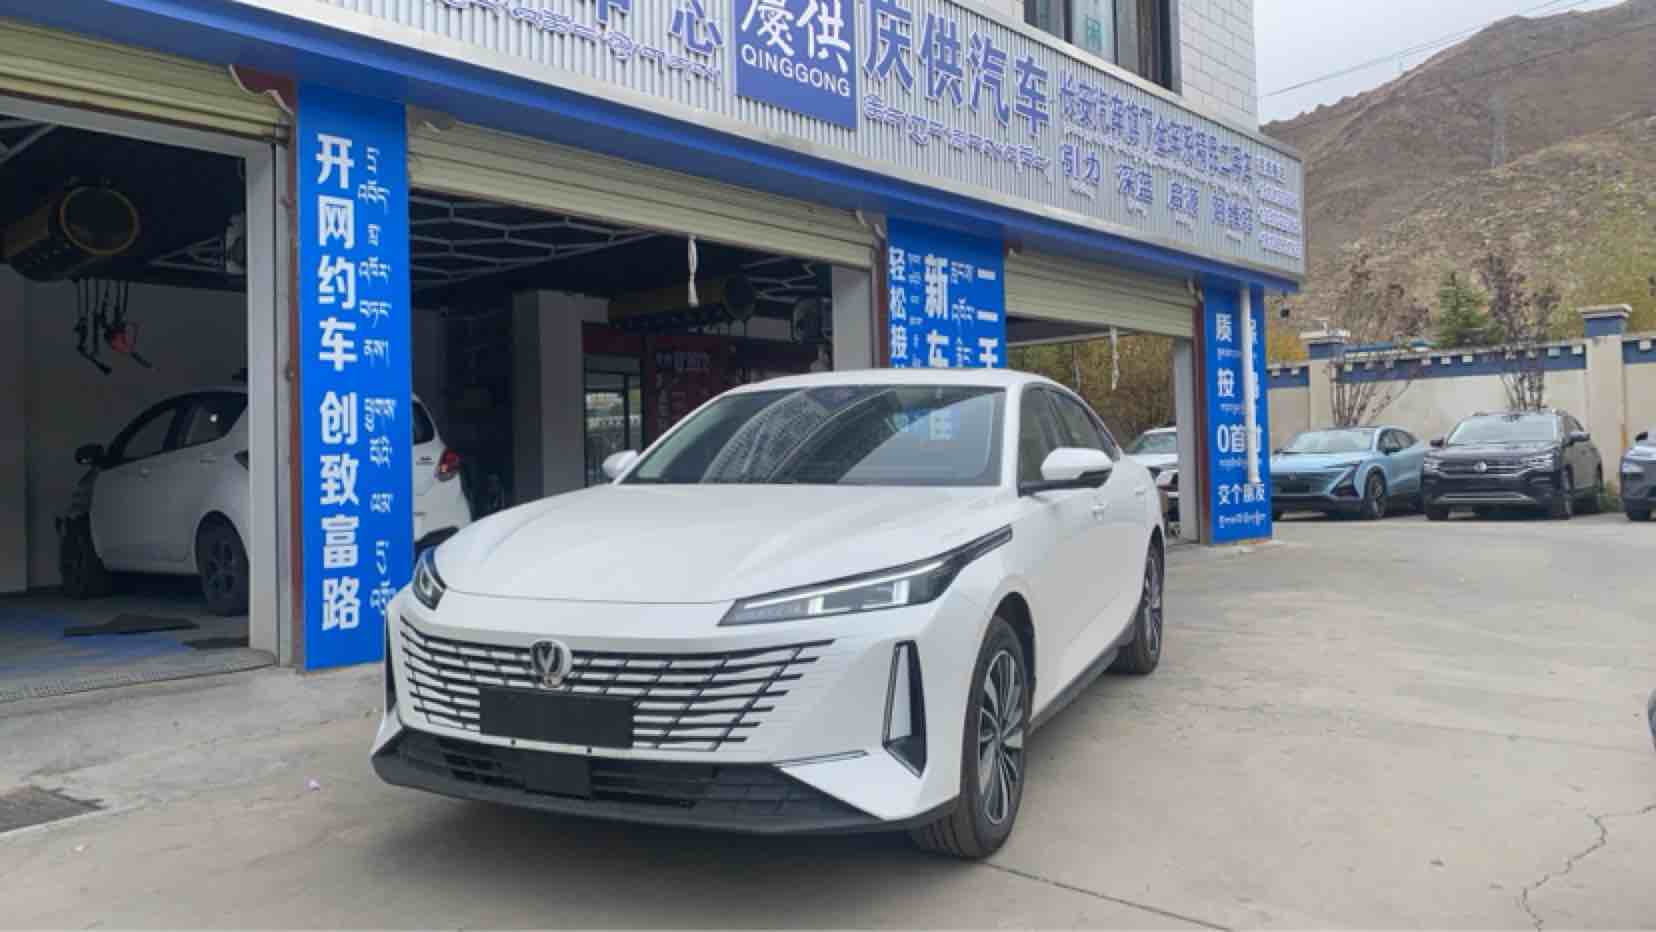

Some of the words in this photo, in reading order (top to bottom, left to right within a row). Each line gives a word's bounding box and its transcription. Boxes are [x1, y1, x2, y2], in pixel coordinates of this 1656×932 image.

[741, 43, 851, 98] QINGGONG
[863, 0, 1050, 135] 庆供汽车
[1061, 143, 1101, 186] 引力
[315, 132, 358, 372] 开网约车
[320, 390, 361, 631] 创致富路
